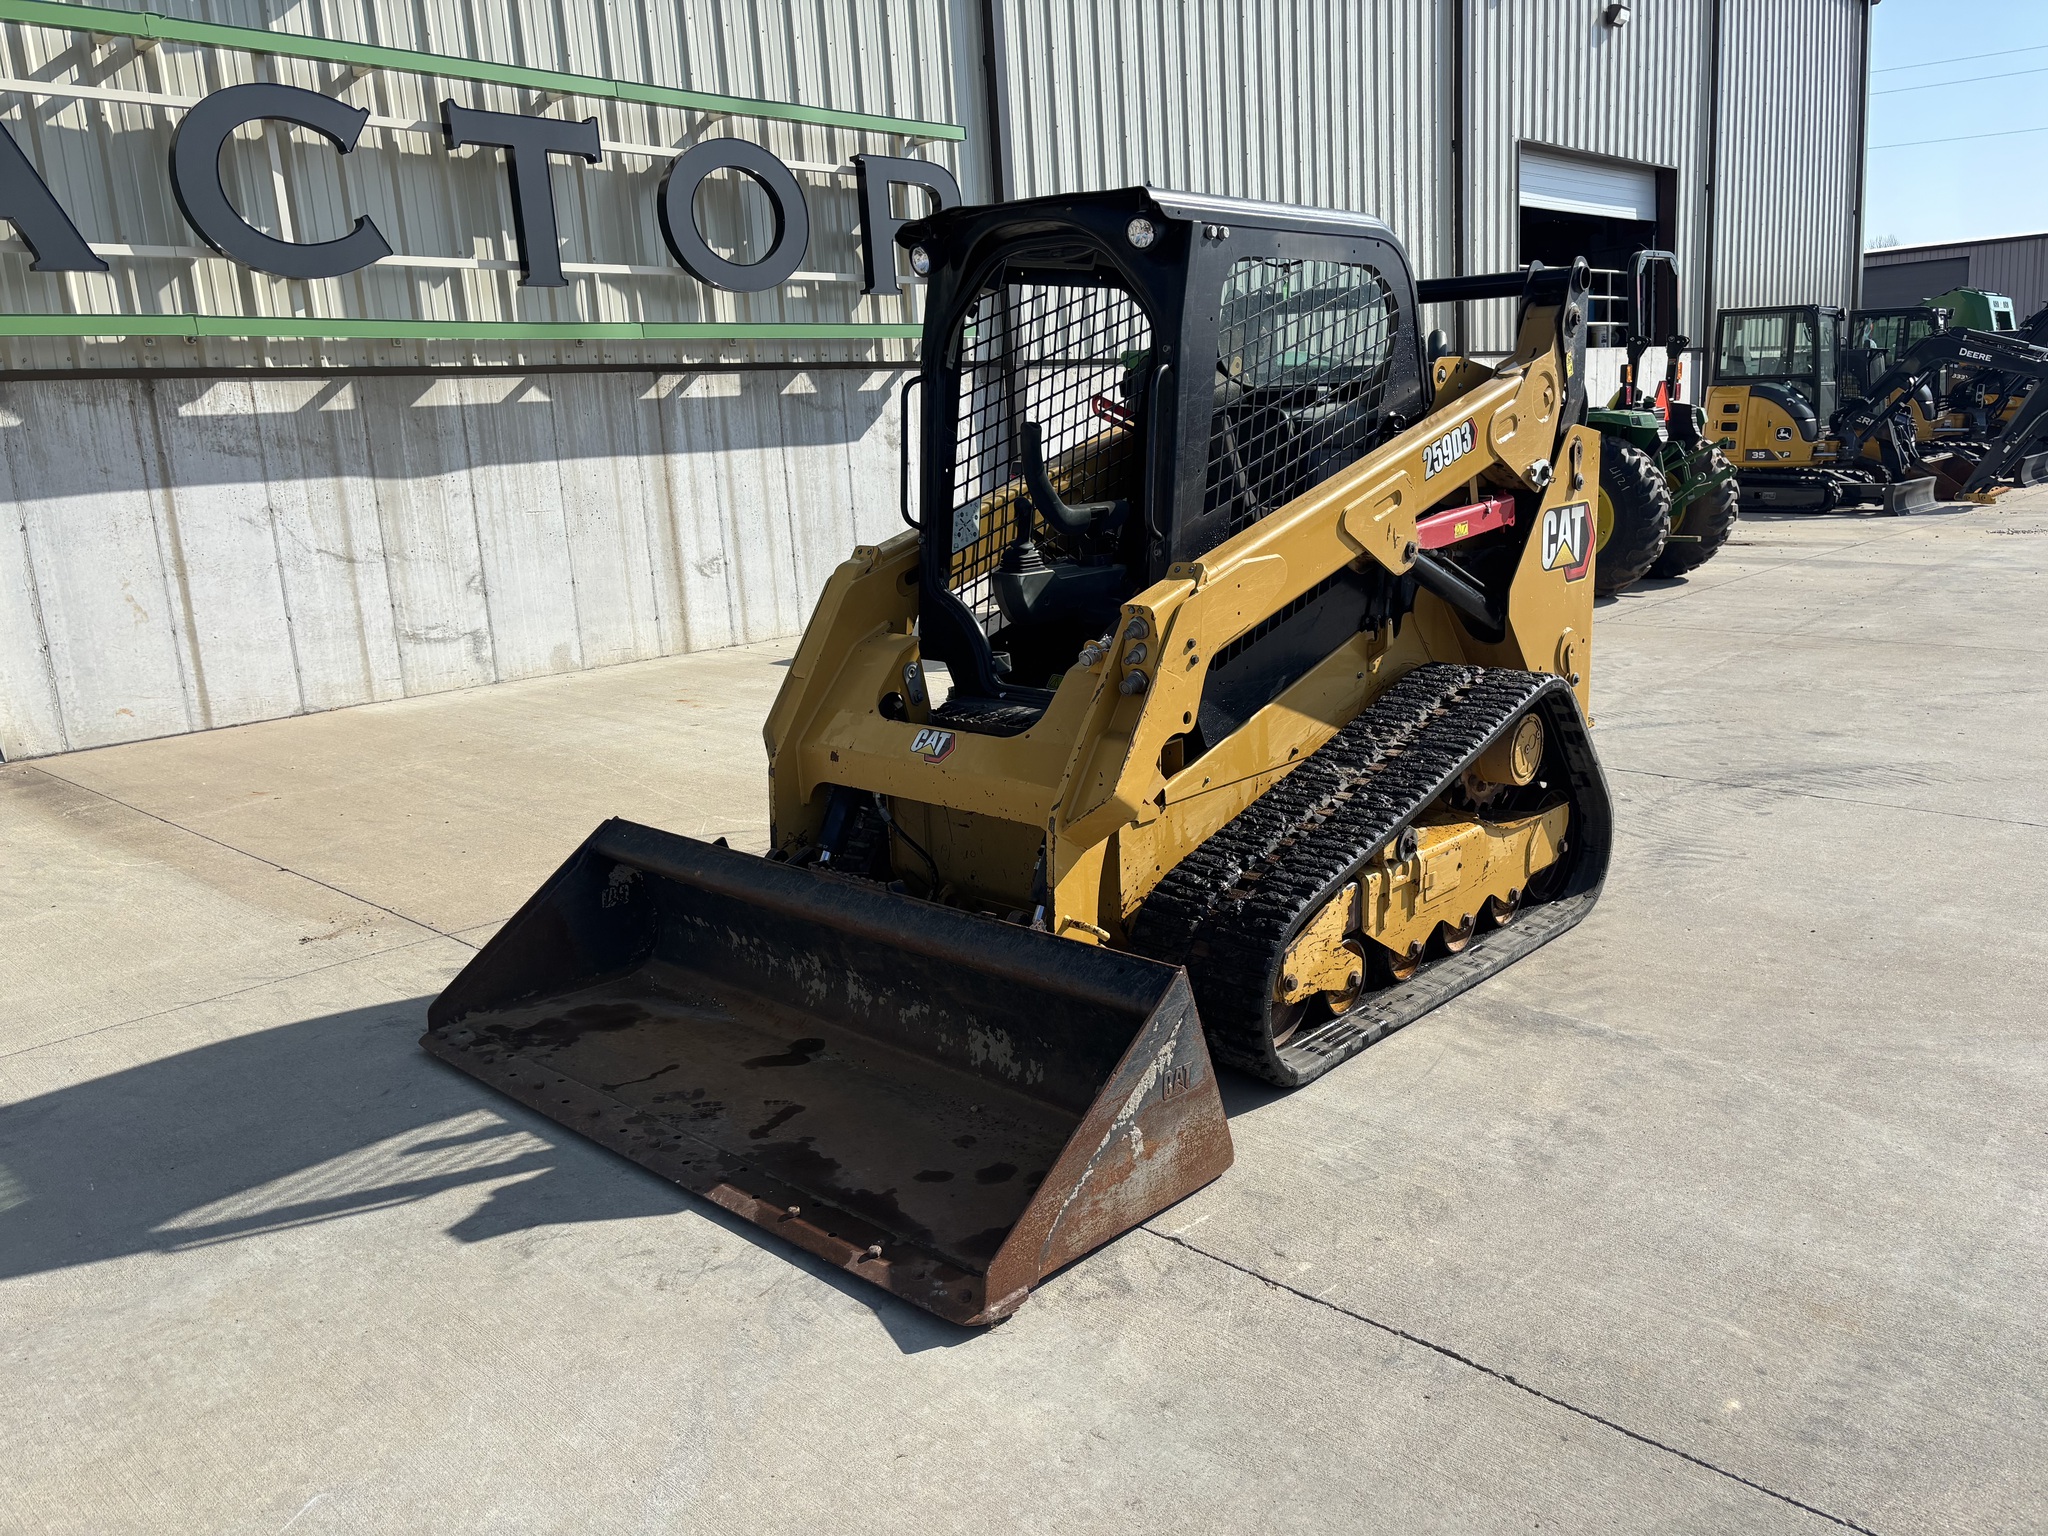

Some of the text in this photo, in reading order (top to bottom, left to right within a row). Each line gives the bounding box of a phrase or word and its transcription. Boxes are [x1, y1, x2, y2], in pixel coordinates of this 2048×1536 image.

[1959, 347, 1993, 362] DEERE
[1422, 420, 1472, 481] 259D3
[1751, 451, 1766, 459] 35
[1542, 505, 1585, 570] CAT
[910, 729, 952, 756] CAT
[1162, 1061, 1193, 1101] CAT
